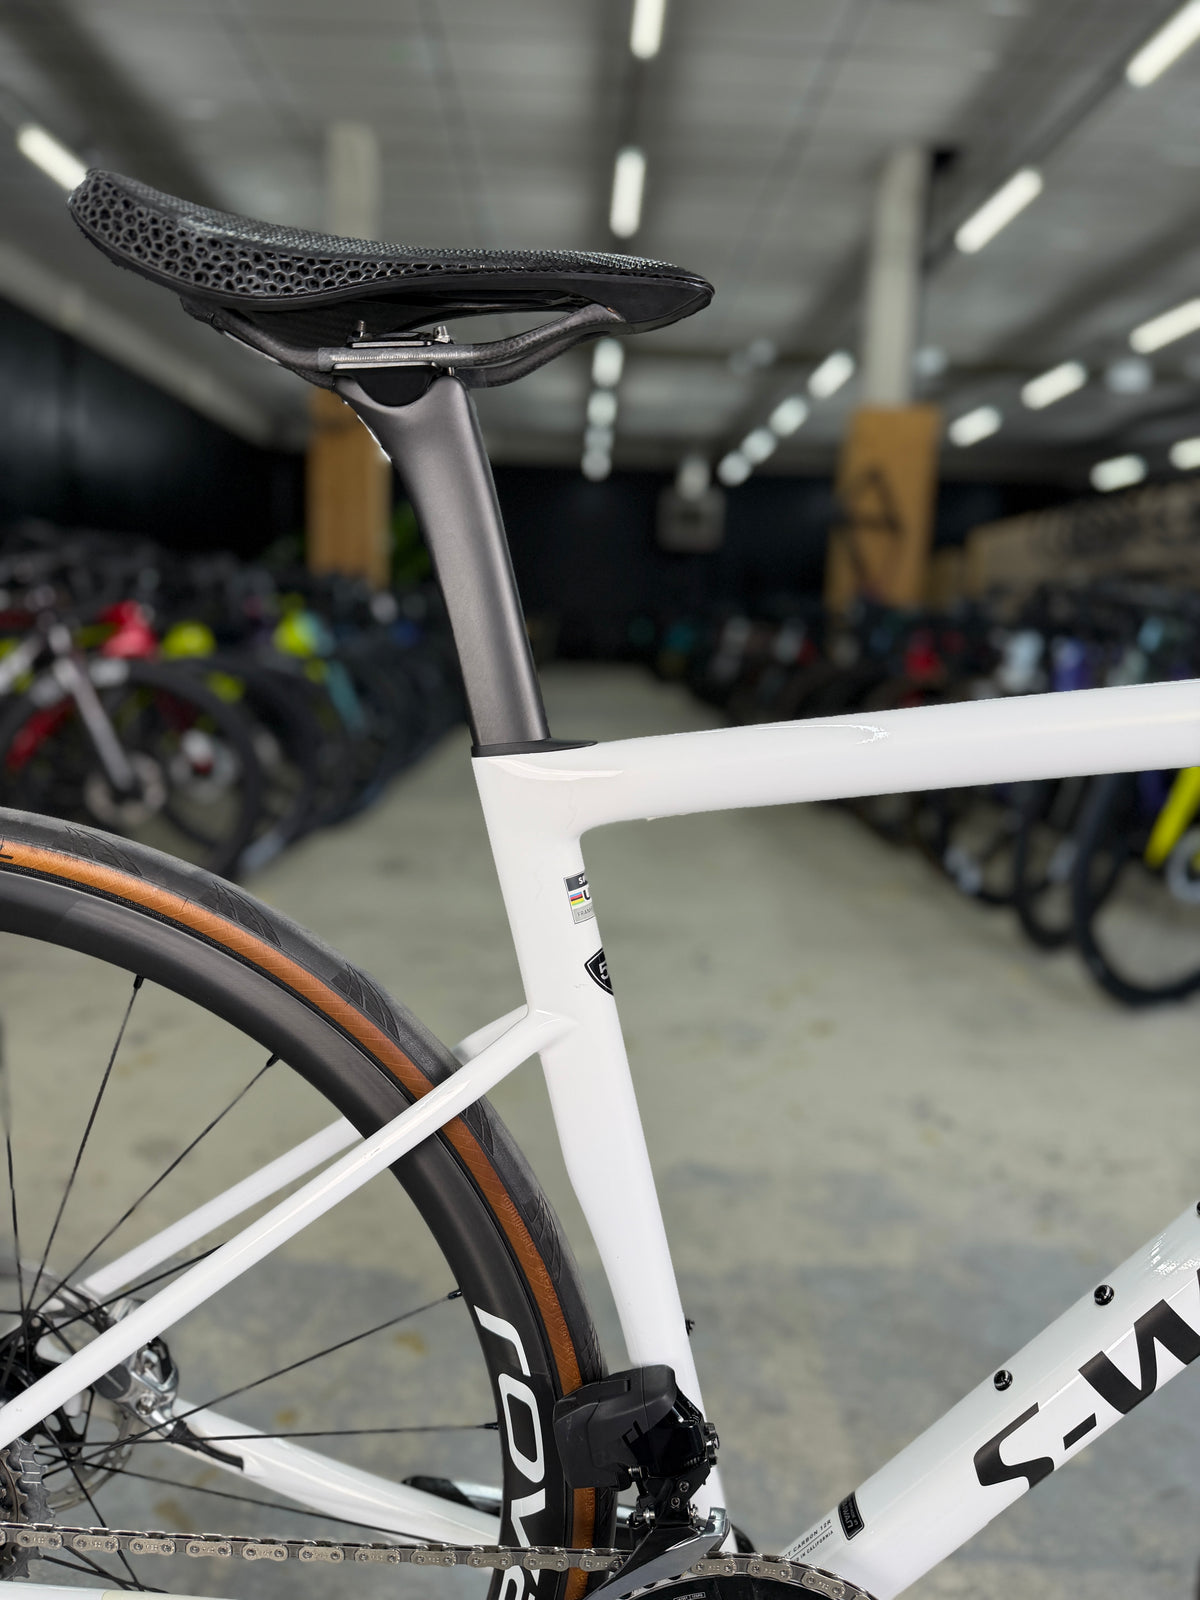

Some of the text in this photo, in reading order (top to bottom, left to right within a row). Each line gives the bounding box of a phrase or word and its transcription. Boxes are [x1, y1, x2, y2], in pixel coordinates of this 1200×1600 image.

[793, 1529, 819, 1552] CARBON
[820, 1519, 832, 1531] 12R
[806, 1530, 834, 1554] CALIFORNIA
